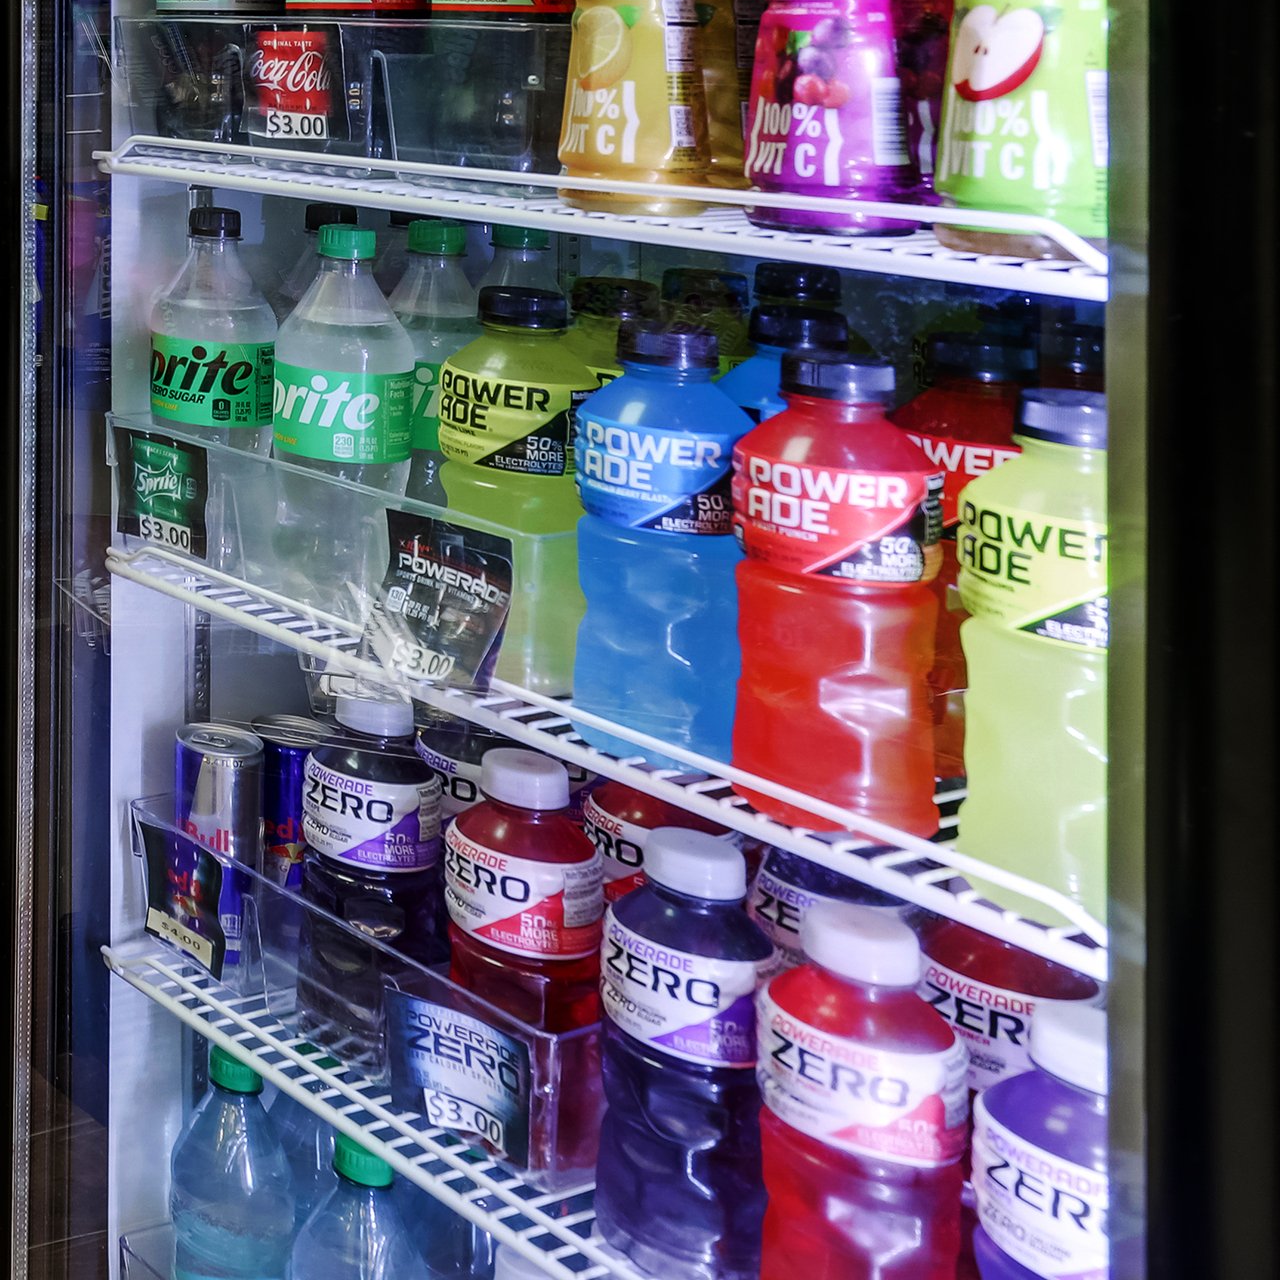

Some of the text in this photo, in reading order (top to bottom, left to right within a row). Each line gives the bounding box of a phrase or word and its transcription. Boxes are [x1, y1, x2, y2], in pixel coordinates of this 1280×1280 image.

[250, 48, 332, 93] Coca-Cola
[267, 113, 325, 137] $3.00
[762, 104, 822, 139] 100%
[752, 139, 818, 177] VIT C
[167, 387, 206, 405] SUGAR
[218, 400, 225, 412] 0
[441, 369, 551, 413] POWER
[439, 397, 488, 431] ADE
[335, 434, 353, 448] 230
[525, 450, 565, 463] MORE
[526, 435, 564, 452] 50%
[585, 420, 723, 470] POWER
[494, 455, 565, 471] ELECTROLYTES
[583, 457, 654, 491] ADE
[135, 470, 179, 493] Sprite
[749, 455, 909, 510] POWER
[747, 493, 830, 535] ADE
[140, 516, 191, 550] $3.00
[960, 534, 1032, 585] ADE
[398, 552, 510, 607] POWERADE
[395, 641, 453, 679] $3.00
[307, 762, 374, 797] POWERADE
[306, 776, 395, 824] ZERO
[357, 848, 417, 864] ELECTROLYTES
[383, 843, 415, 856] MORE
[160, 920, 202, 952] $4.00
[518, 925, 559, 943] MORE
[607, 921, 695, 975] POWERADE
[606, 940, 722, 1010] ZERO
[406, 1023, 520, 1096] ZERO
[771, 1026, 911, 1110] ZERO
[428, 1091, 501, 1144] $3.00
